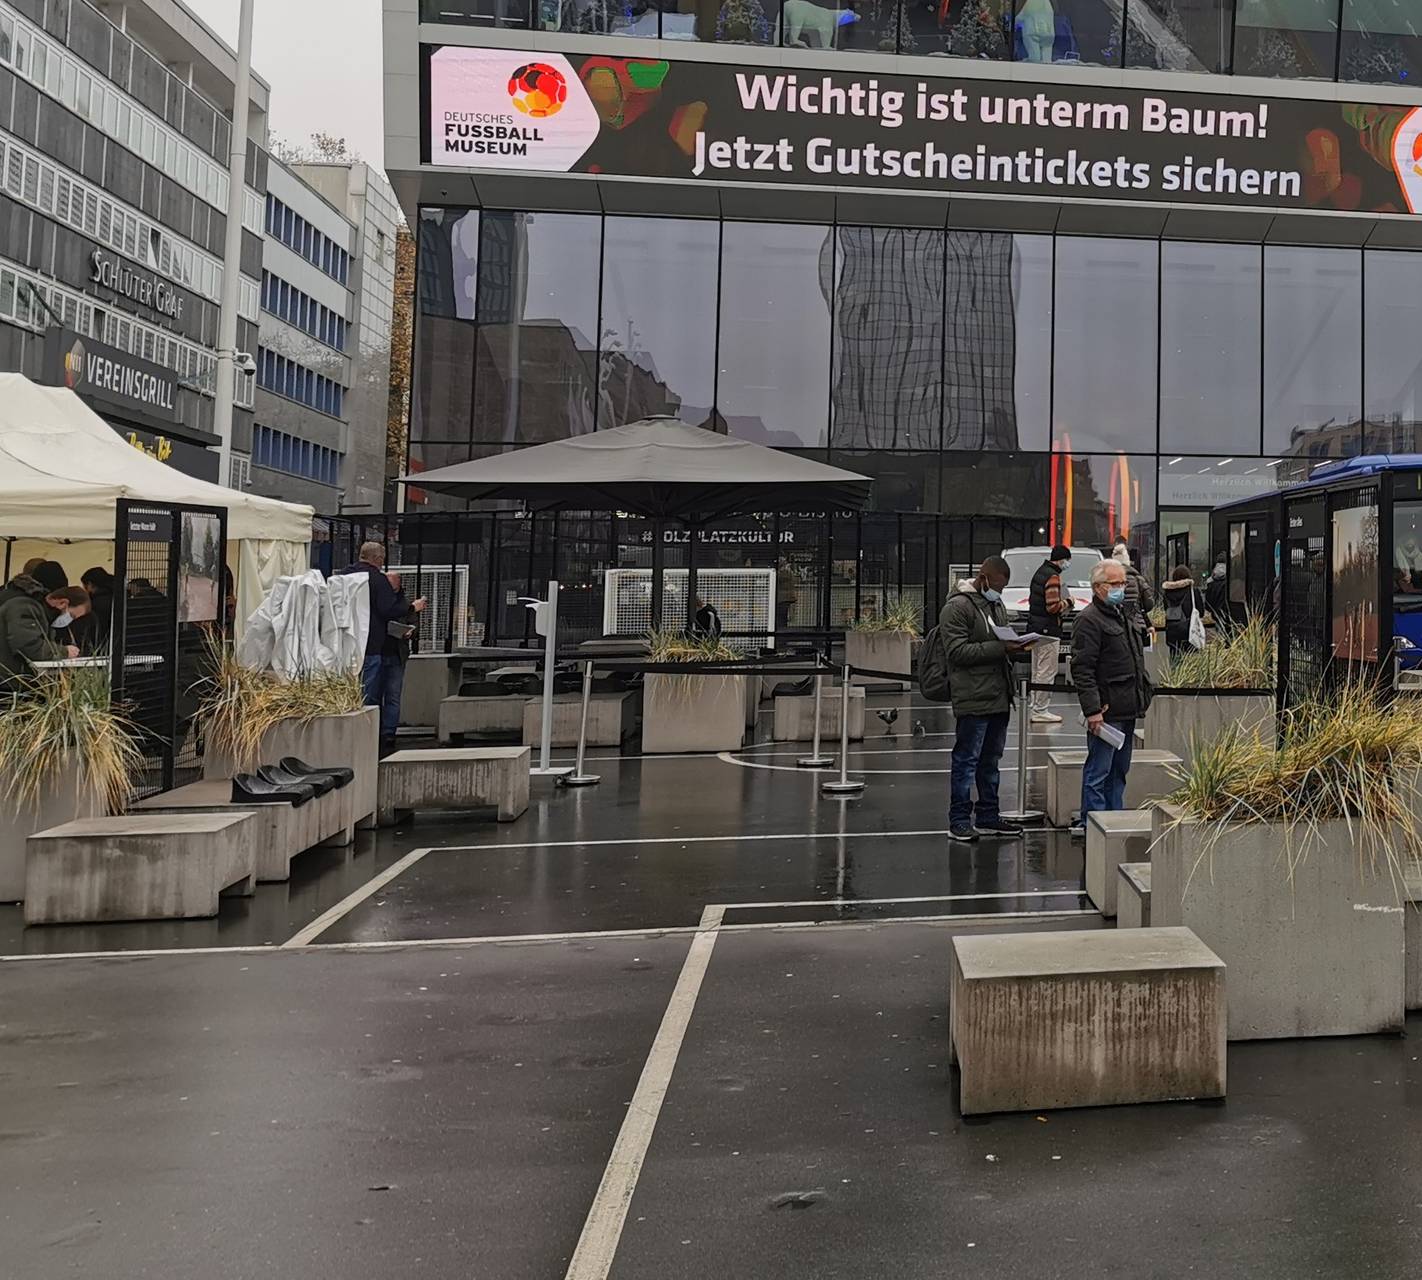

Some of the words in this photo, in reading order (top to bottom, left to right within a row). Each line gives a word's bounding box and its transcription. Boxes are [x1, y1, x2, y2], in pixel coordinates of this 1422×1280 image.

[444, 111, 514, 124] DEUTSCHES
[735, 73, 905, 128] Wichtig
[916, 82, 968, 121] ist
[979, 93, 1129, 131] unterm
[1142, 98, 1268, 139] Baum!
[444, 123, 544, 141] FUSSBALL
[444, 139, 527, 156] MUSEUM
[691, 131, 794, 176] Jetzt
[806, 137, 1151, 190] Gutscheintickets
[1161, 155, 1301, 197] sichern
[86, 352, 174, 410] VEREINSGRILL
